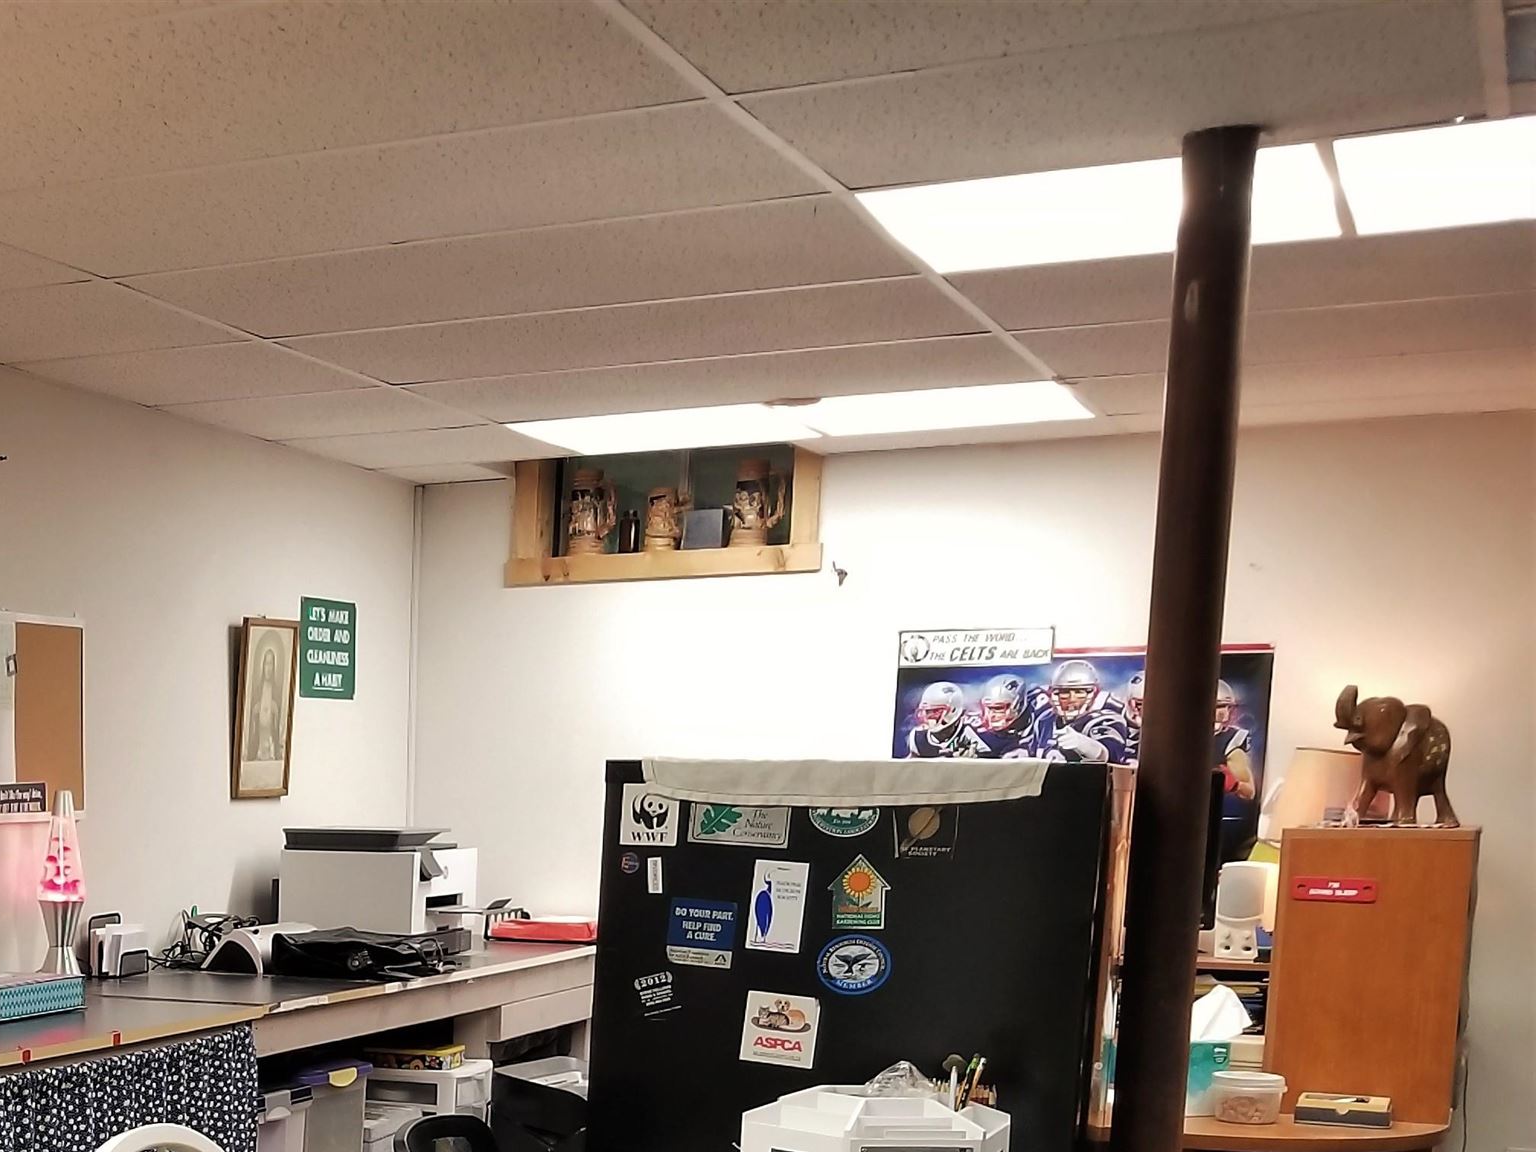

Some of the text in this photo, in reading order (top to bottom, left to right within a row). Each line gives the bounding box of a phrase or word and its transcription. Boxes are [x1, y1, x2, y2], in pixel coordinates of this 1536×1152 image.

[333, 629, 350, 644] AND
[932, 634, 958, 643] PASS
[963, 633, 980, 642] THE
[930, 651, 946, 661] THE
[949, 646, 998, 661] CELTS
[1000, 649, 1017, 659] ARE
[630, 831, 669, 843] WWF
[675, 907, 687, 916] DO
[688, 908, 711, 919] YOUR
[682, 920, 722, 932] HELP FIND
[640, 974, 667, 988] 2012
[753, 1036, 803, 1053] ASPCA
